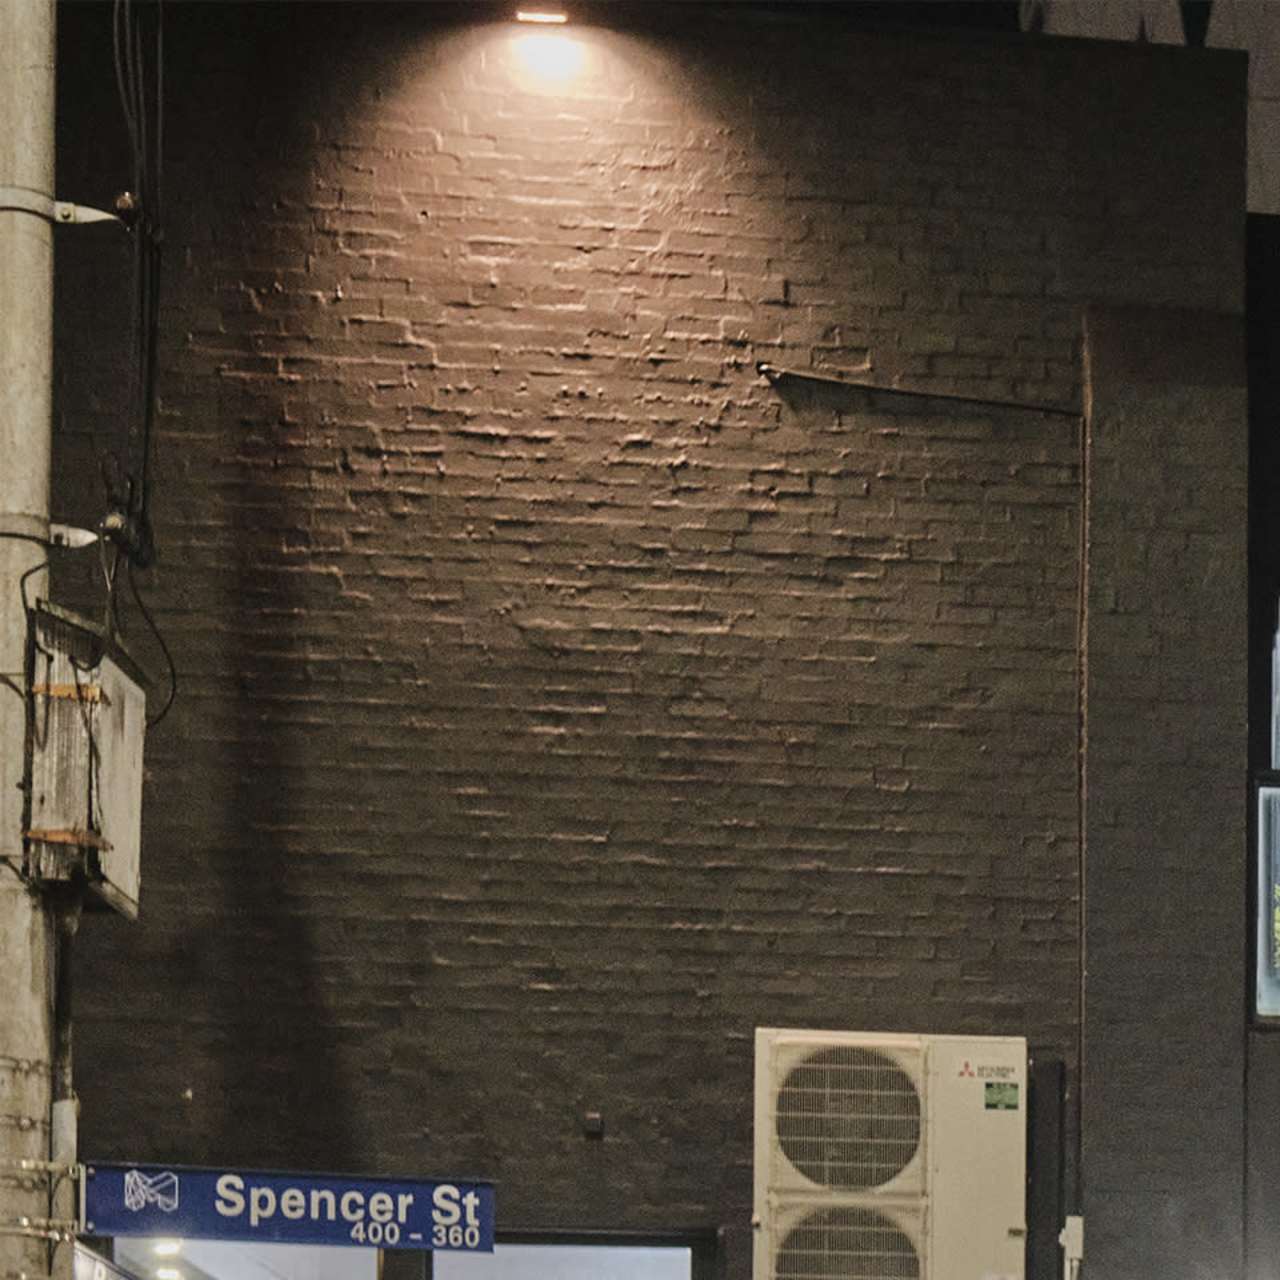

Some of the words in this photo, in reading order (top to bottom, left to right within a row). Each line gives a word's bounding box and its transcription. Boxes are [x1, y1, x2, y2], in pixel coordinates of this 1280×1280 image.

[214, 1173, 413, 1227] Spencer
[431, 1184, 480, 1227] St
[350, 1221, 400, 1246] 400
[431, 1225, 480, 1249] 360
